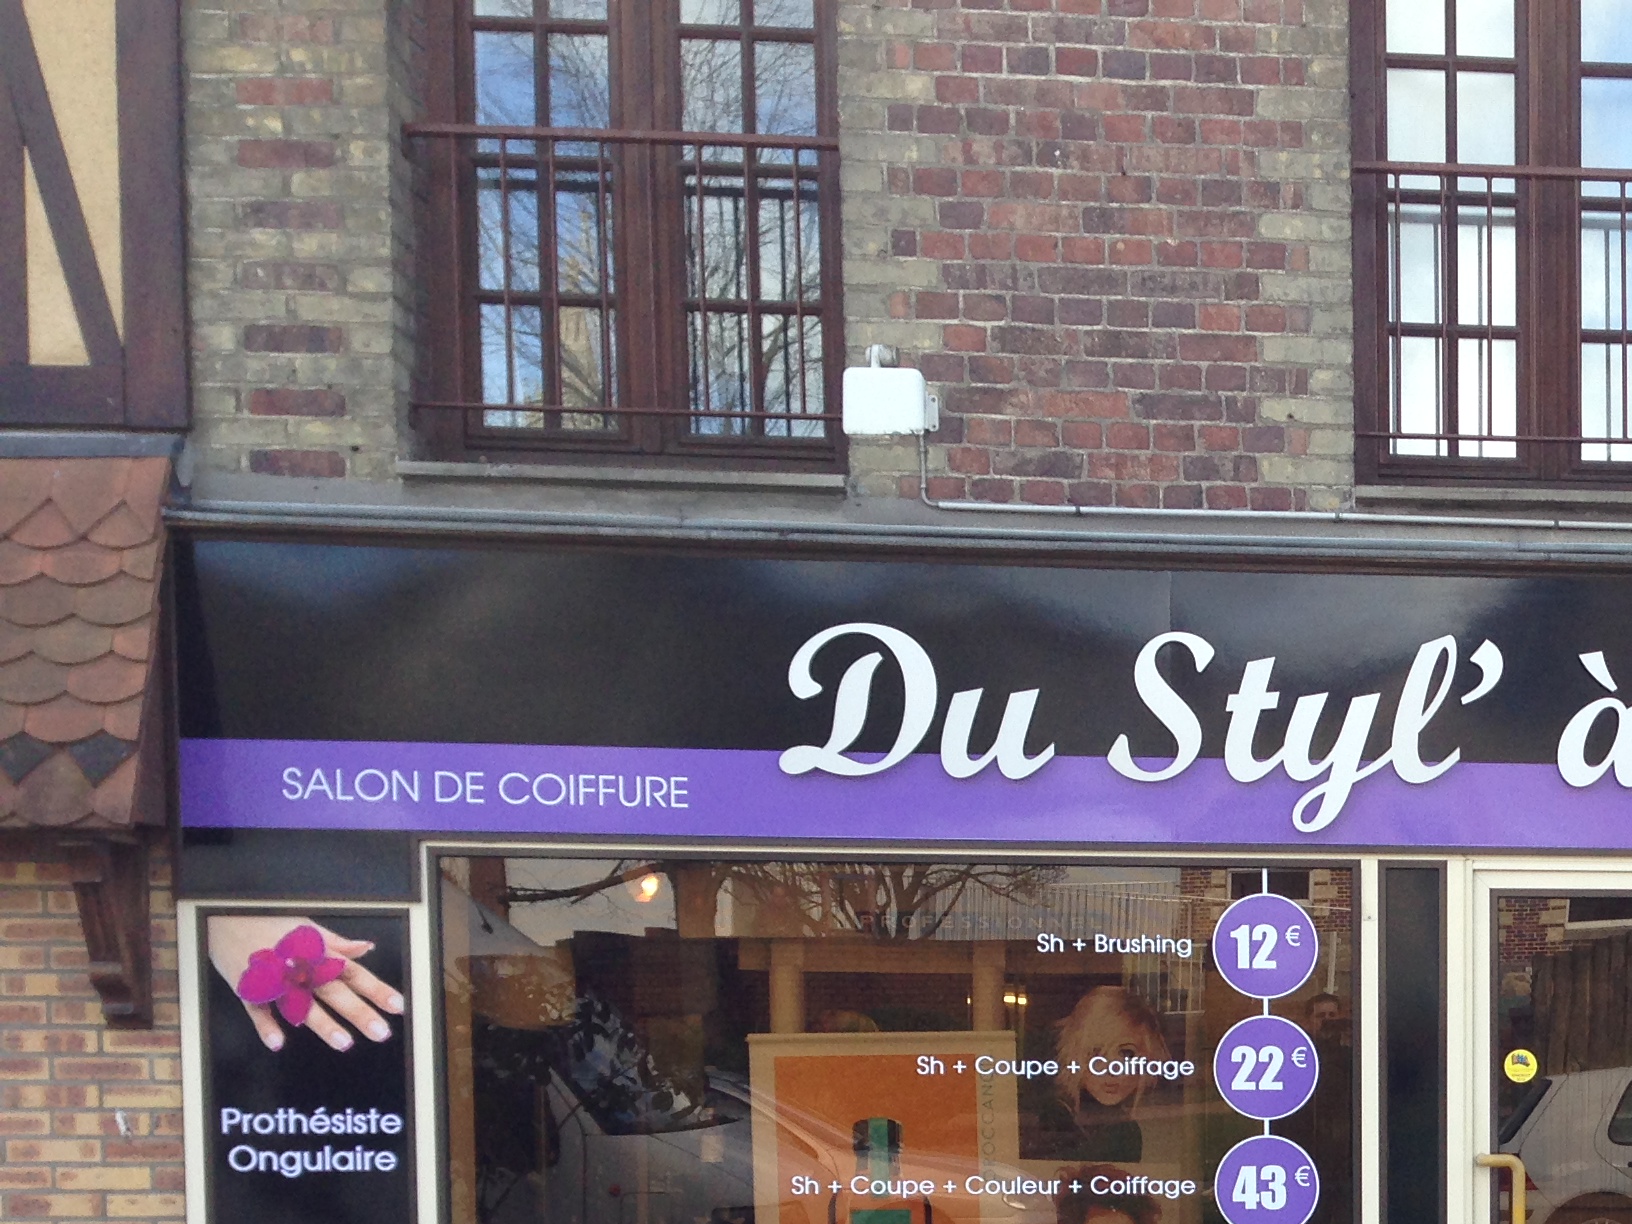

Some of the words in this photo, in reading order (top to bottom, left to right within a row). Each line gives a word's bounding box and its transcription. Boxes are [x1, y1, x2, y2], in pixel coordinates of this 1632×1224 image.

[777, 621, 1056, 781] Du
[1105, 630, 1505, 834] Styl'
[281, 766, 421, 804] SALON
[433, 770, 485, 805] DE
[497, 771, 689, 809] COIFFURE
[1036, 932, 1064, 953] Sh
[1072, 937, 1087, 952] +
[1094, 933, 1192, 958] Brushing
[916, 1055, 945, 1075] Sh
[952, 1060, 967, 1074] +
[974, 1055, 1059, 1080] Coupe
[1066, 1060, 1081, 1074] +
[1088, 1056, 1195, 1080] Coiffage
[221, 1106, 403, 1135] Prothésiste
[228, 1145, 398, 1178] Ongulaire
[791, 1175, 820, 1195] Sh
[827, 1180, 843, 1194] +
[850, 1175, 935, 1199] Coupe
[942, 1180, 957, 1194] +
[965, 1175, 1061, 1195] Couleur
[1068, 1180, 1083, 1194] +
[1090, 1175, 1196, 1200] Coiffage
